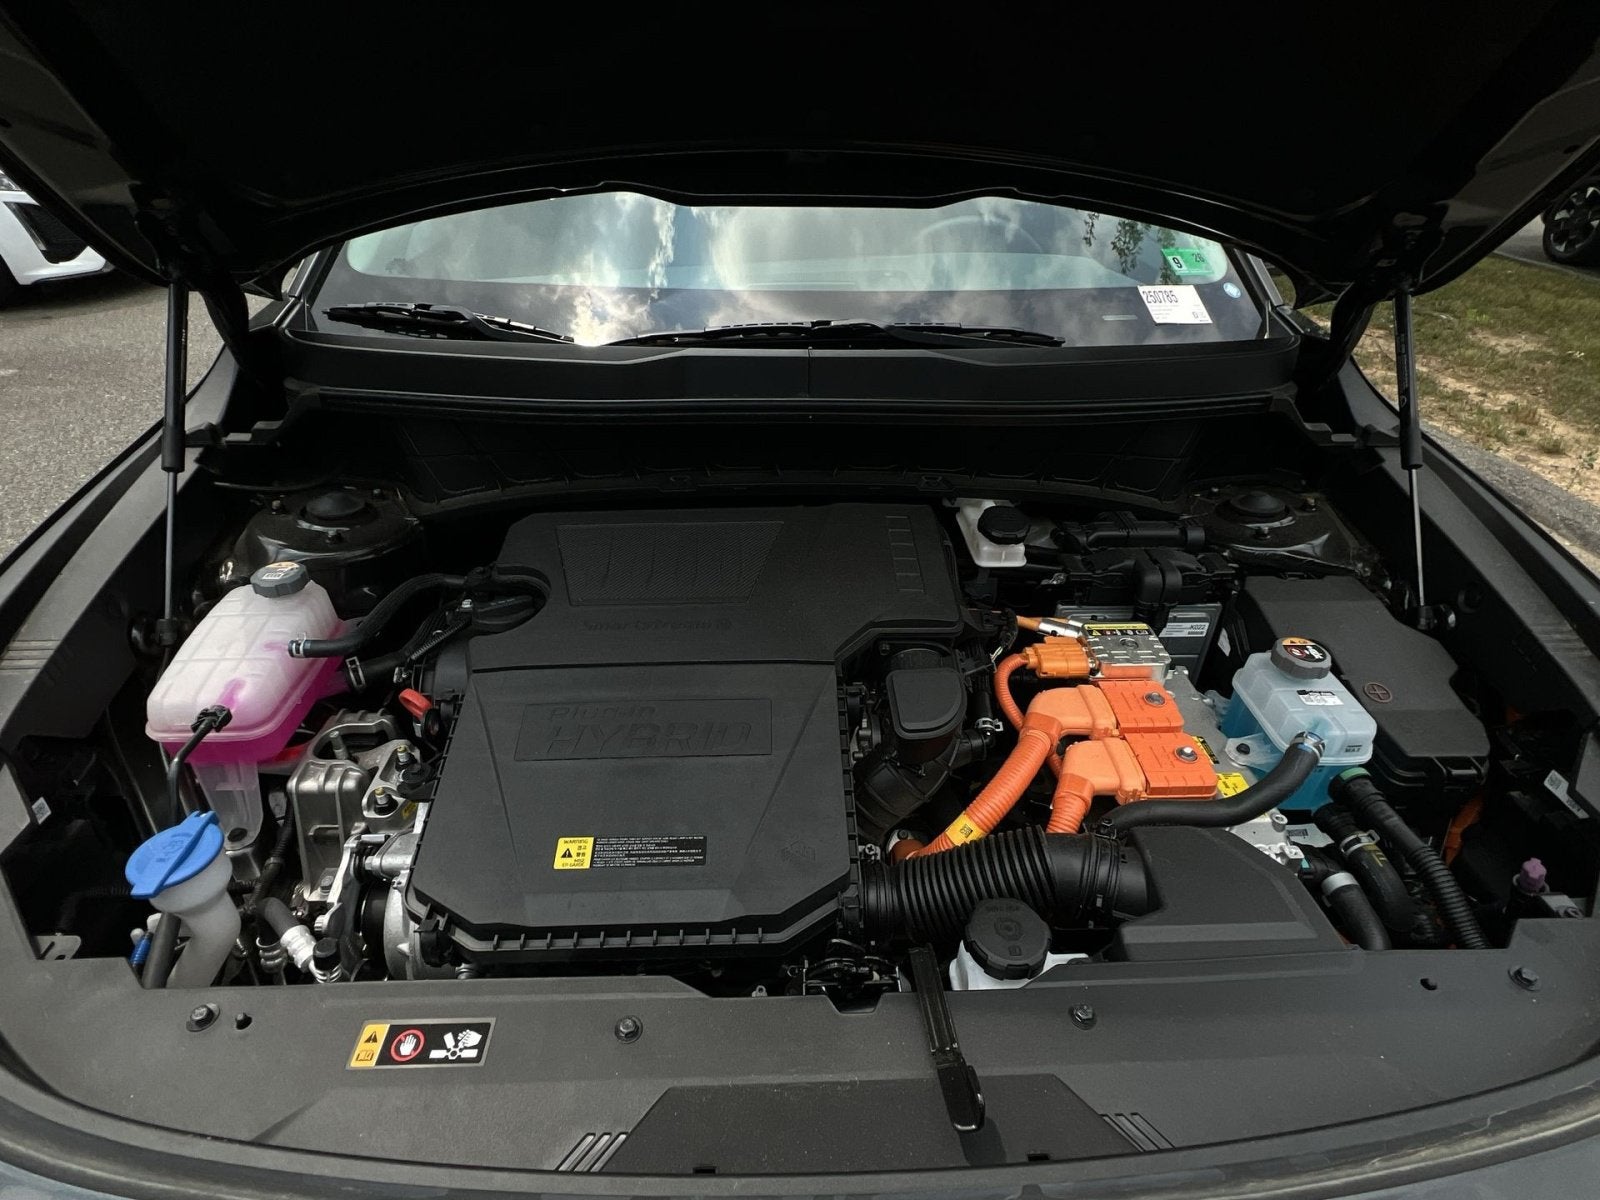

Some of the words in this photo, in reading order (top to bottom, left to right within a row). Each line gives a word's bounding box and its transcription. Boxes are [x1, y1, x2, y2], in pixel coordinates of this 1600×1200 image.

[1172, 256, 1183, 269] 9
[1142, 290, 1179, 304] 250785
[547, 721, 752, 754] HYBRID
